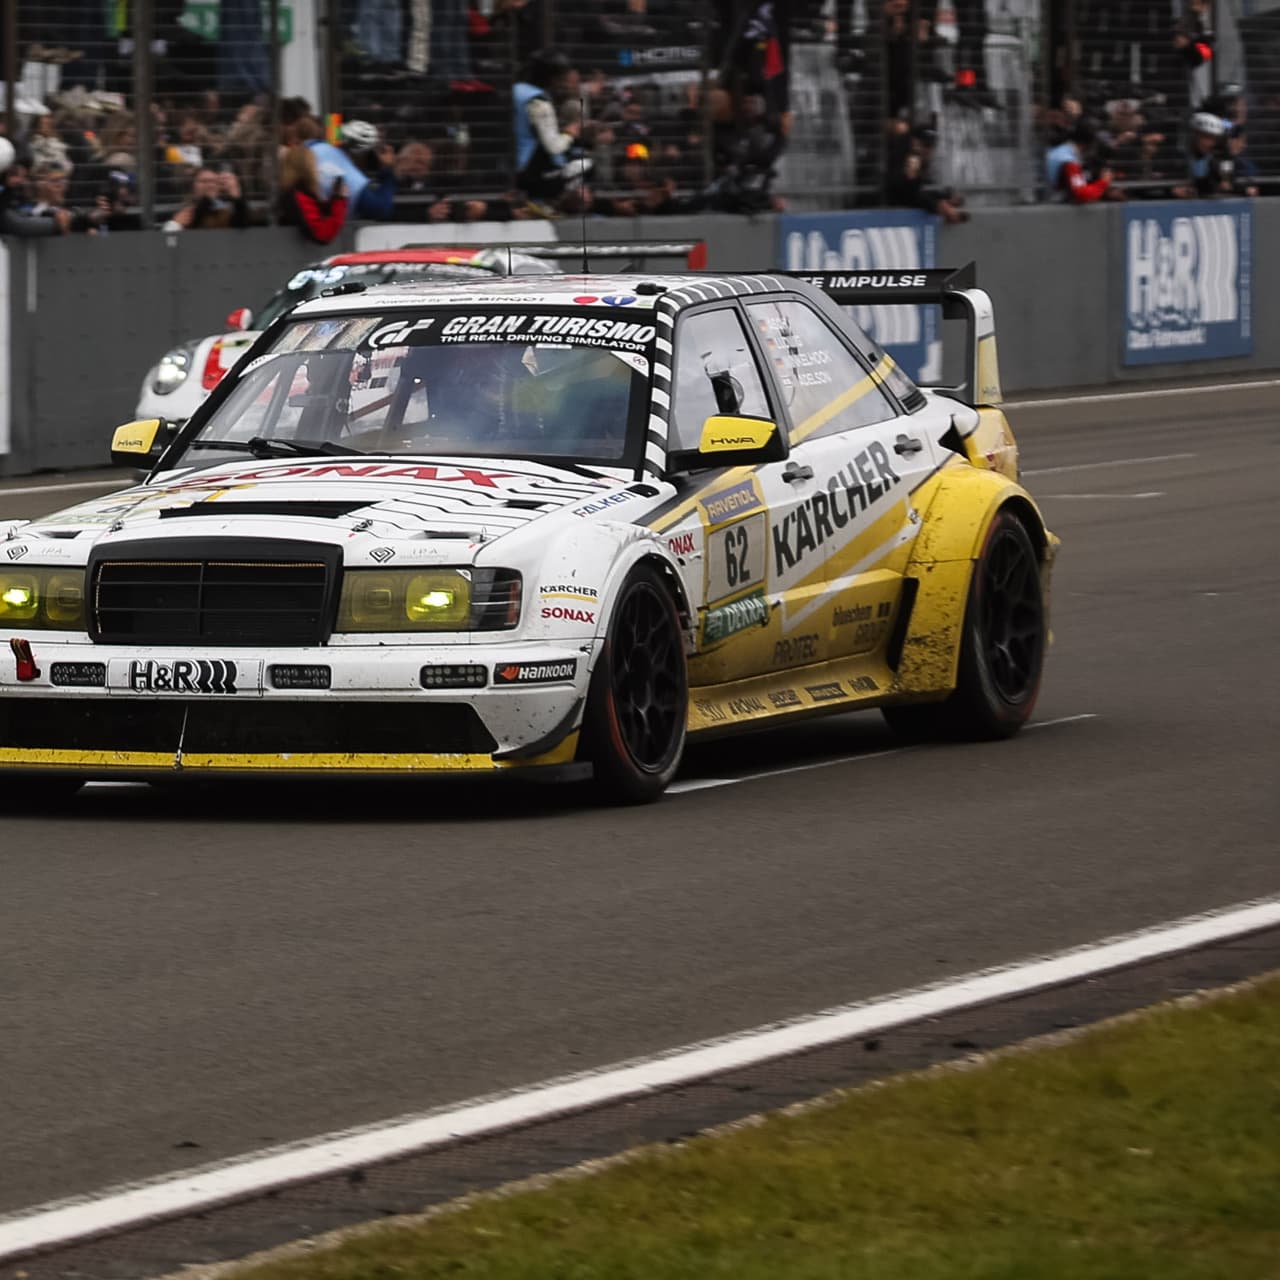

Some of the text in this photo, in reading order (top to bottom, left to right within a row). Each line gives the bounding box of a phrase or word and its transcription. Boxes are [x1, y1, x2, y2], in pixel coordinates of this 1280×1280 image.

[828, 275, 927, 288] IMPULSE
[440, 334, 647, 351] THE REAL DRIVING SIMULATOR
[441, 315, 526, 335] GRAN
[526, 316, 656, 344] TURISMO
[710, 437, 756, 445] HWA
[573, 488, 635, 517] FALKEN
[707, 488, 756, 519] RAVENOL
[773, 441, 901, 577] KÄRCHER
[725, 526, 751, 587] 62
[540, 584, 598, 598] KÄRCHER
[541, 607, 595, 624] SONAX
[726, 596, 767, 632] DEKRA
[130, 659, 198, 693] H&R
